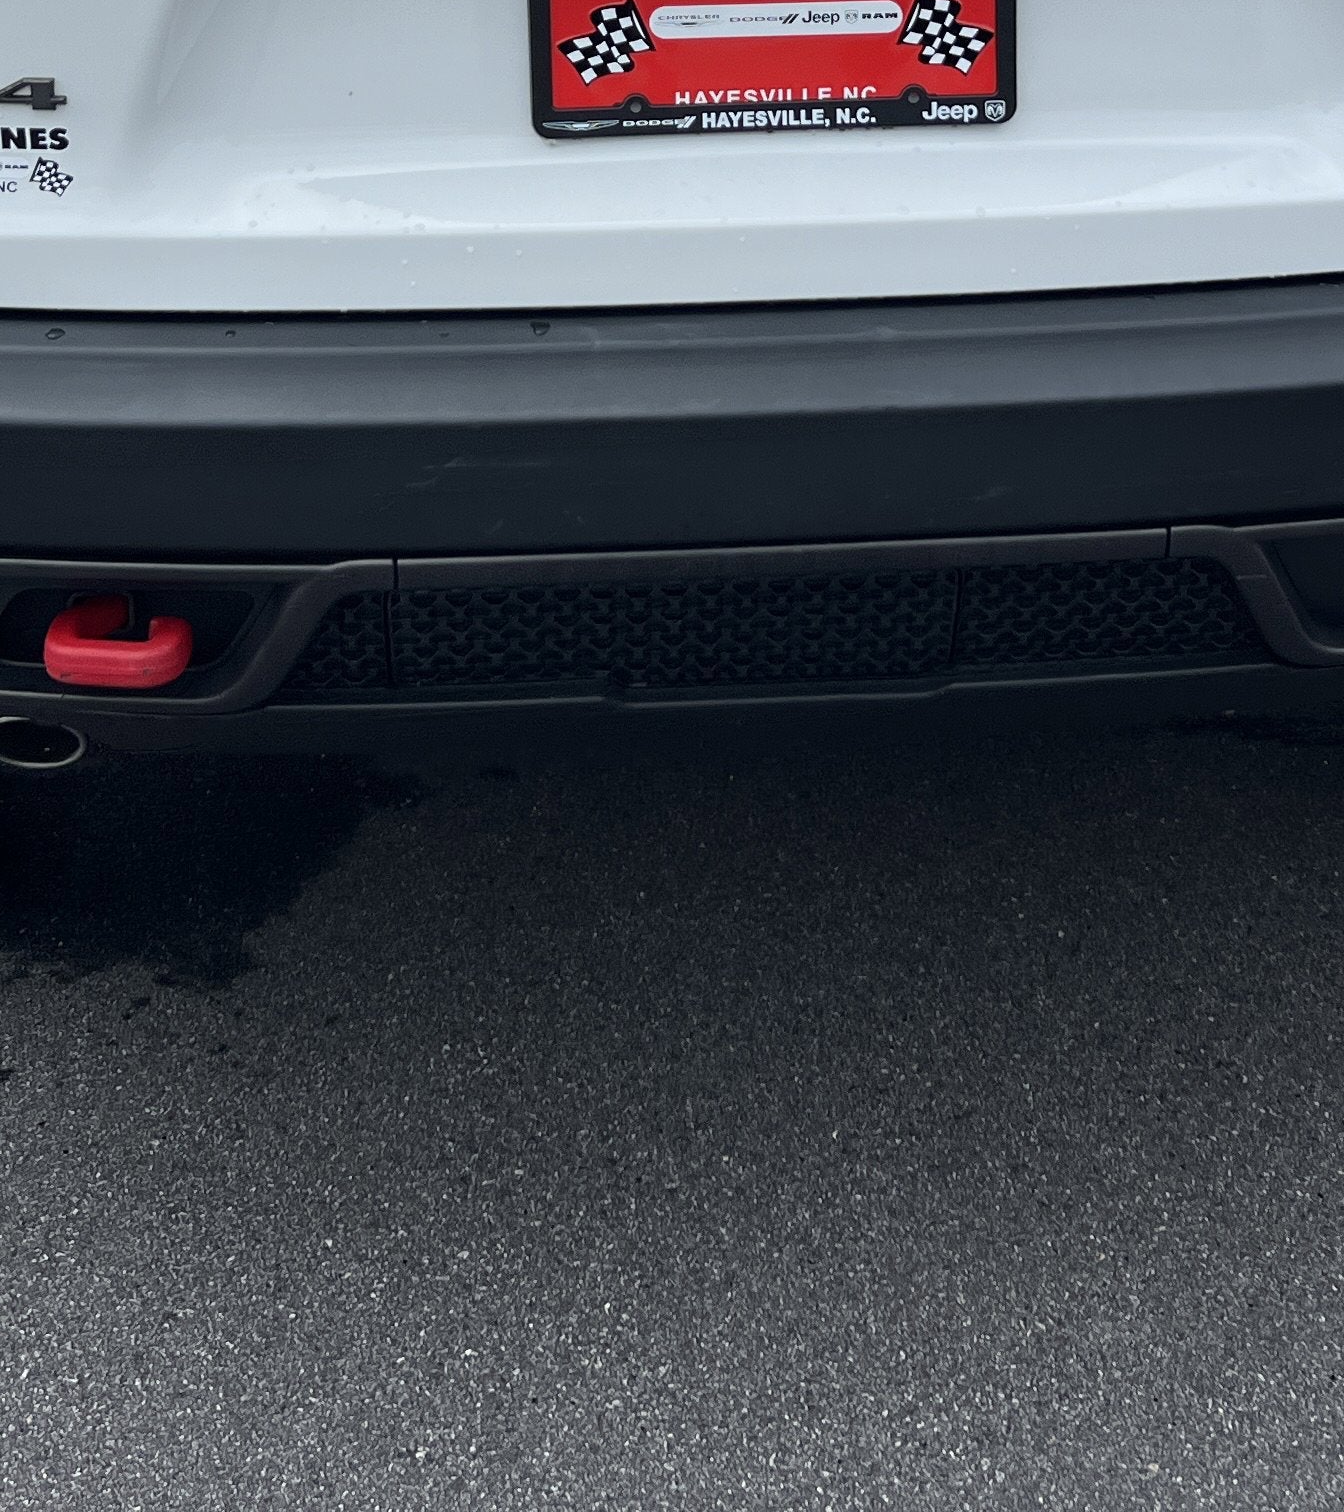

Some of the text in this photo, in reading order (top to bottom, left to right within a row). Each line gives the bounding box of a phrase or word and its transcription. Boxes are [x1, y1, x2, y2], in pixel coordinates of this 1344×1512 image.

[801, 10, 840, 25] Jeep
[701, 106, 877, 129] HAYESVILLE, N.C.
[922, 101, 979, 123] Jeep
